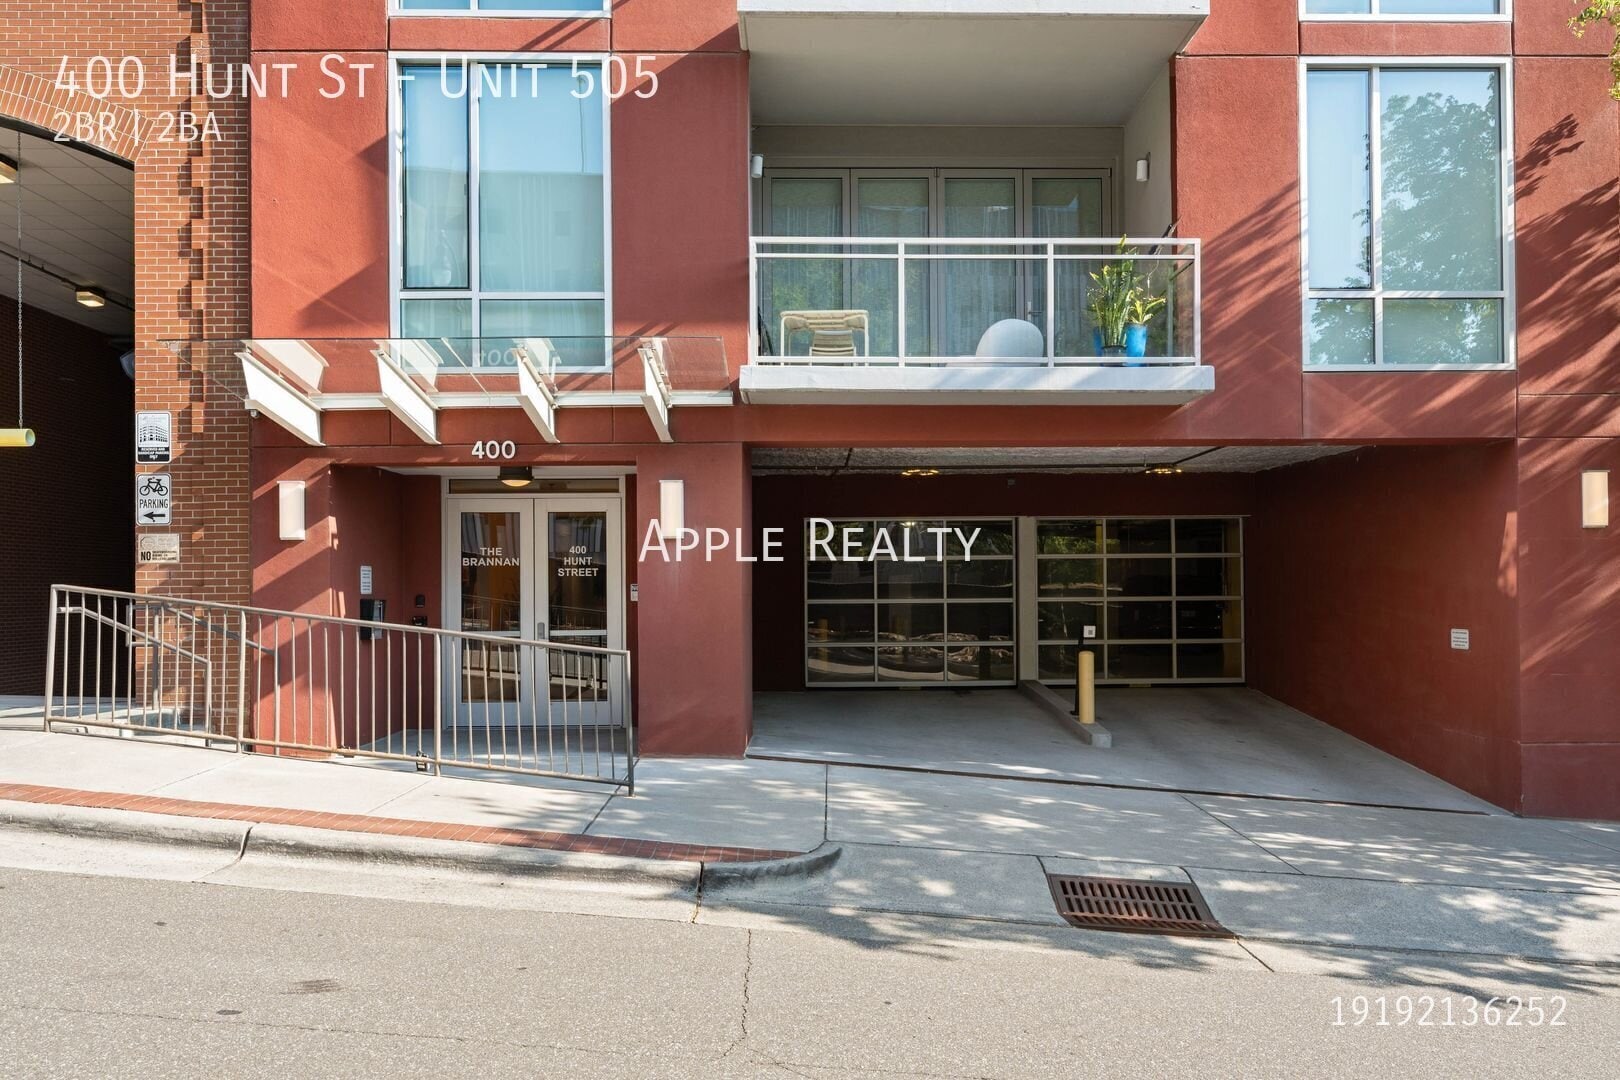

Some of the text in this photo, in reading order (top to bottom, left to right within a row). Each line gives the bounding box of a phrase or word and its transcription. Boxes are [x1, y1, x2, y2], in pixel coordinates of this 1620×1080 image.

[471, 440, 516, 459] 400
[139, 499, 169, 509] PARKING
[479, 547, 503, 556] THE
[569, 545, 587, 555] 400
[140, 551, 152, 561] NO
[563, 556, 593, 566] HUNT
[462, 557, 520, 567] BRANNAN
[557, 567, 599, 577] STREET
